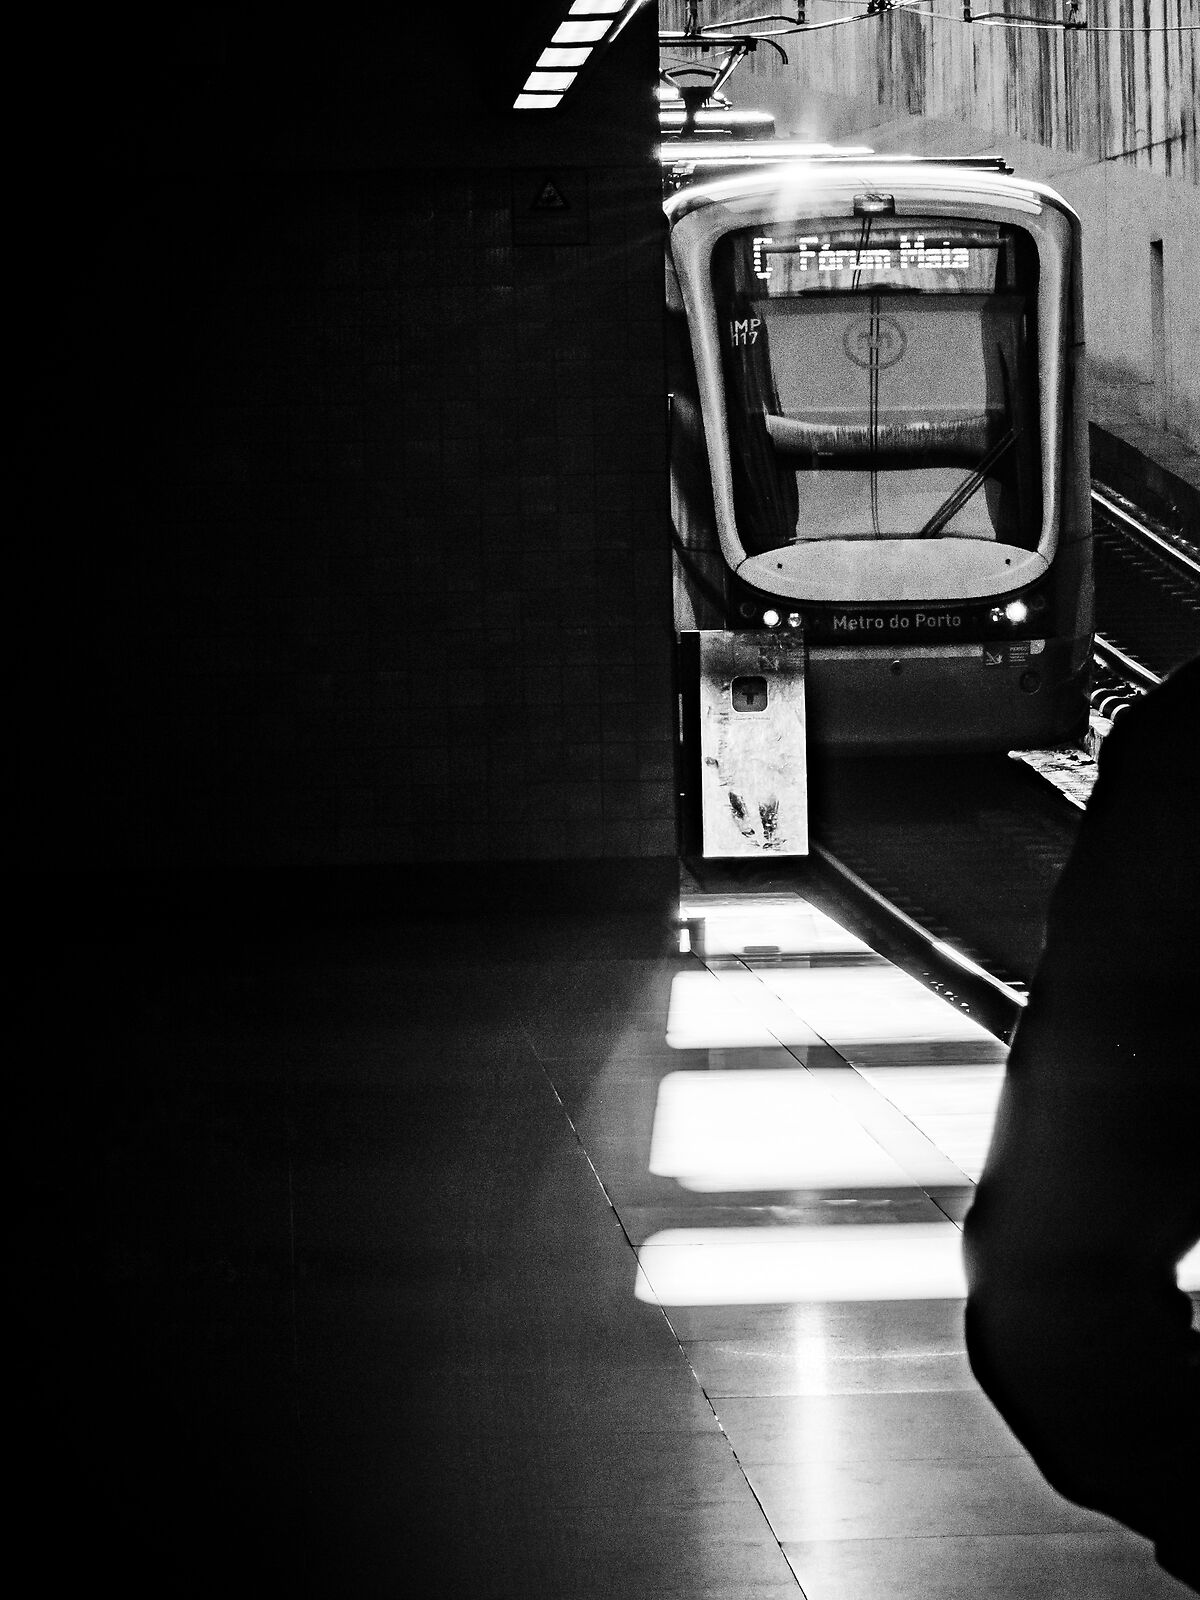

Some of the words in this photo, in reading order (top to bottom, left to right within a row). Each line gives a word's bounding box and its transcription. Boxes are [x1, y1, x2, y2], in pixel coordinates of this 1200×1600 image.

[900, 234, 969, 269] Maia
[734, 318, 761, 333] MP
[733, 331, 758, 346] 117
[833, 615, 884, 632] Metro
[889, 613, 910, 629] do
[915, 613, 961, 629] Porto
